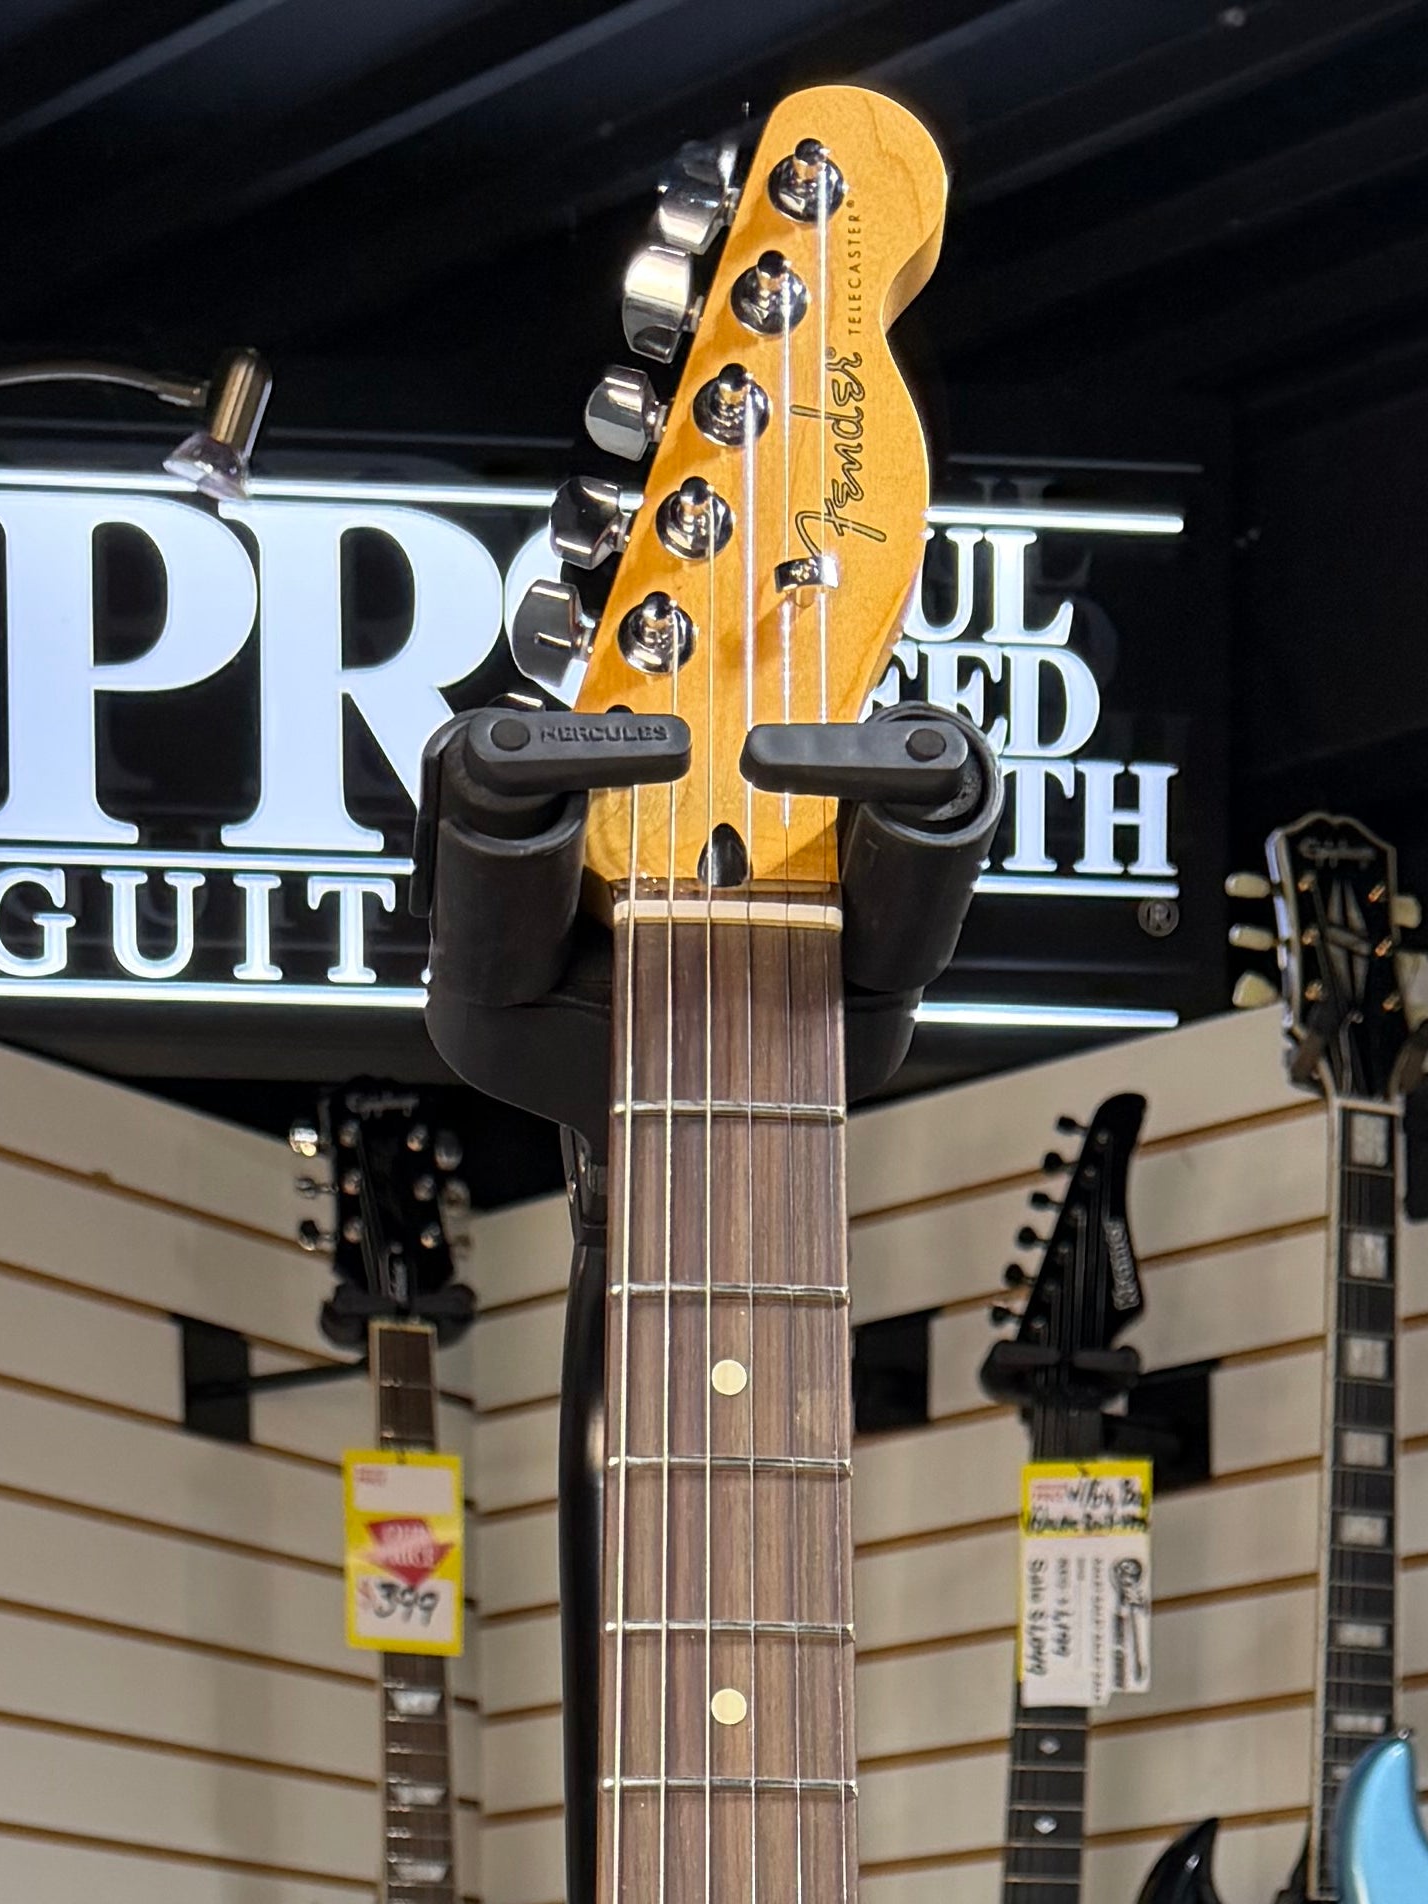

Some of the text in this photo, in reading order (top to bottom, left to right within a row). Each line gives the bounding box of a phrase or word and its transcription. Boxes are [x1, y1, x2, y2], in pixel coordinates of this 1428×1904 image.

[790, 350, 887, 559] Fender
[902, 527, 1073, 646] UL
[540, 724, 669, 745] HERCULES
